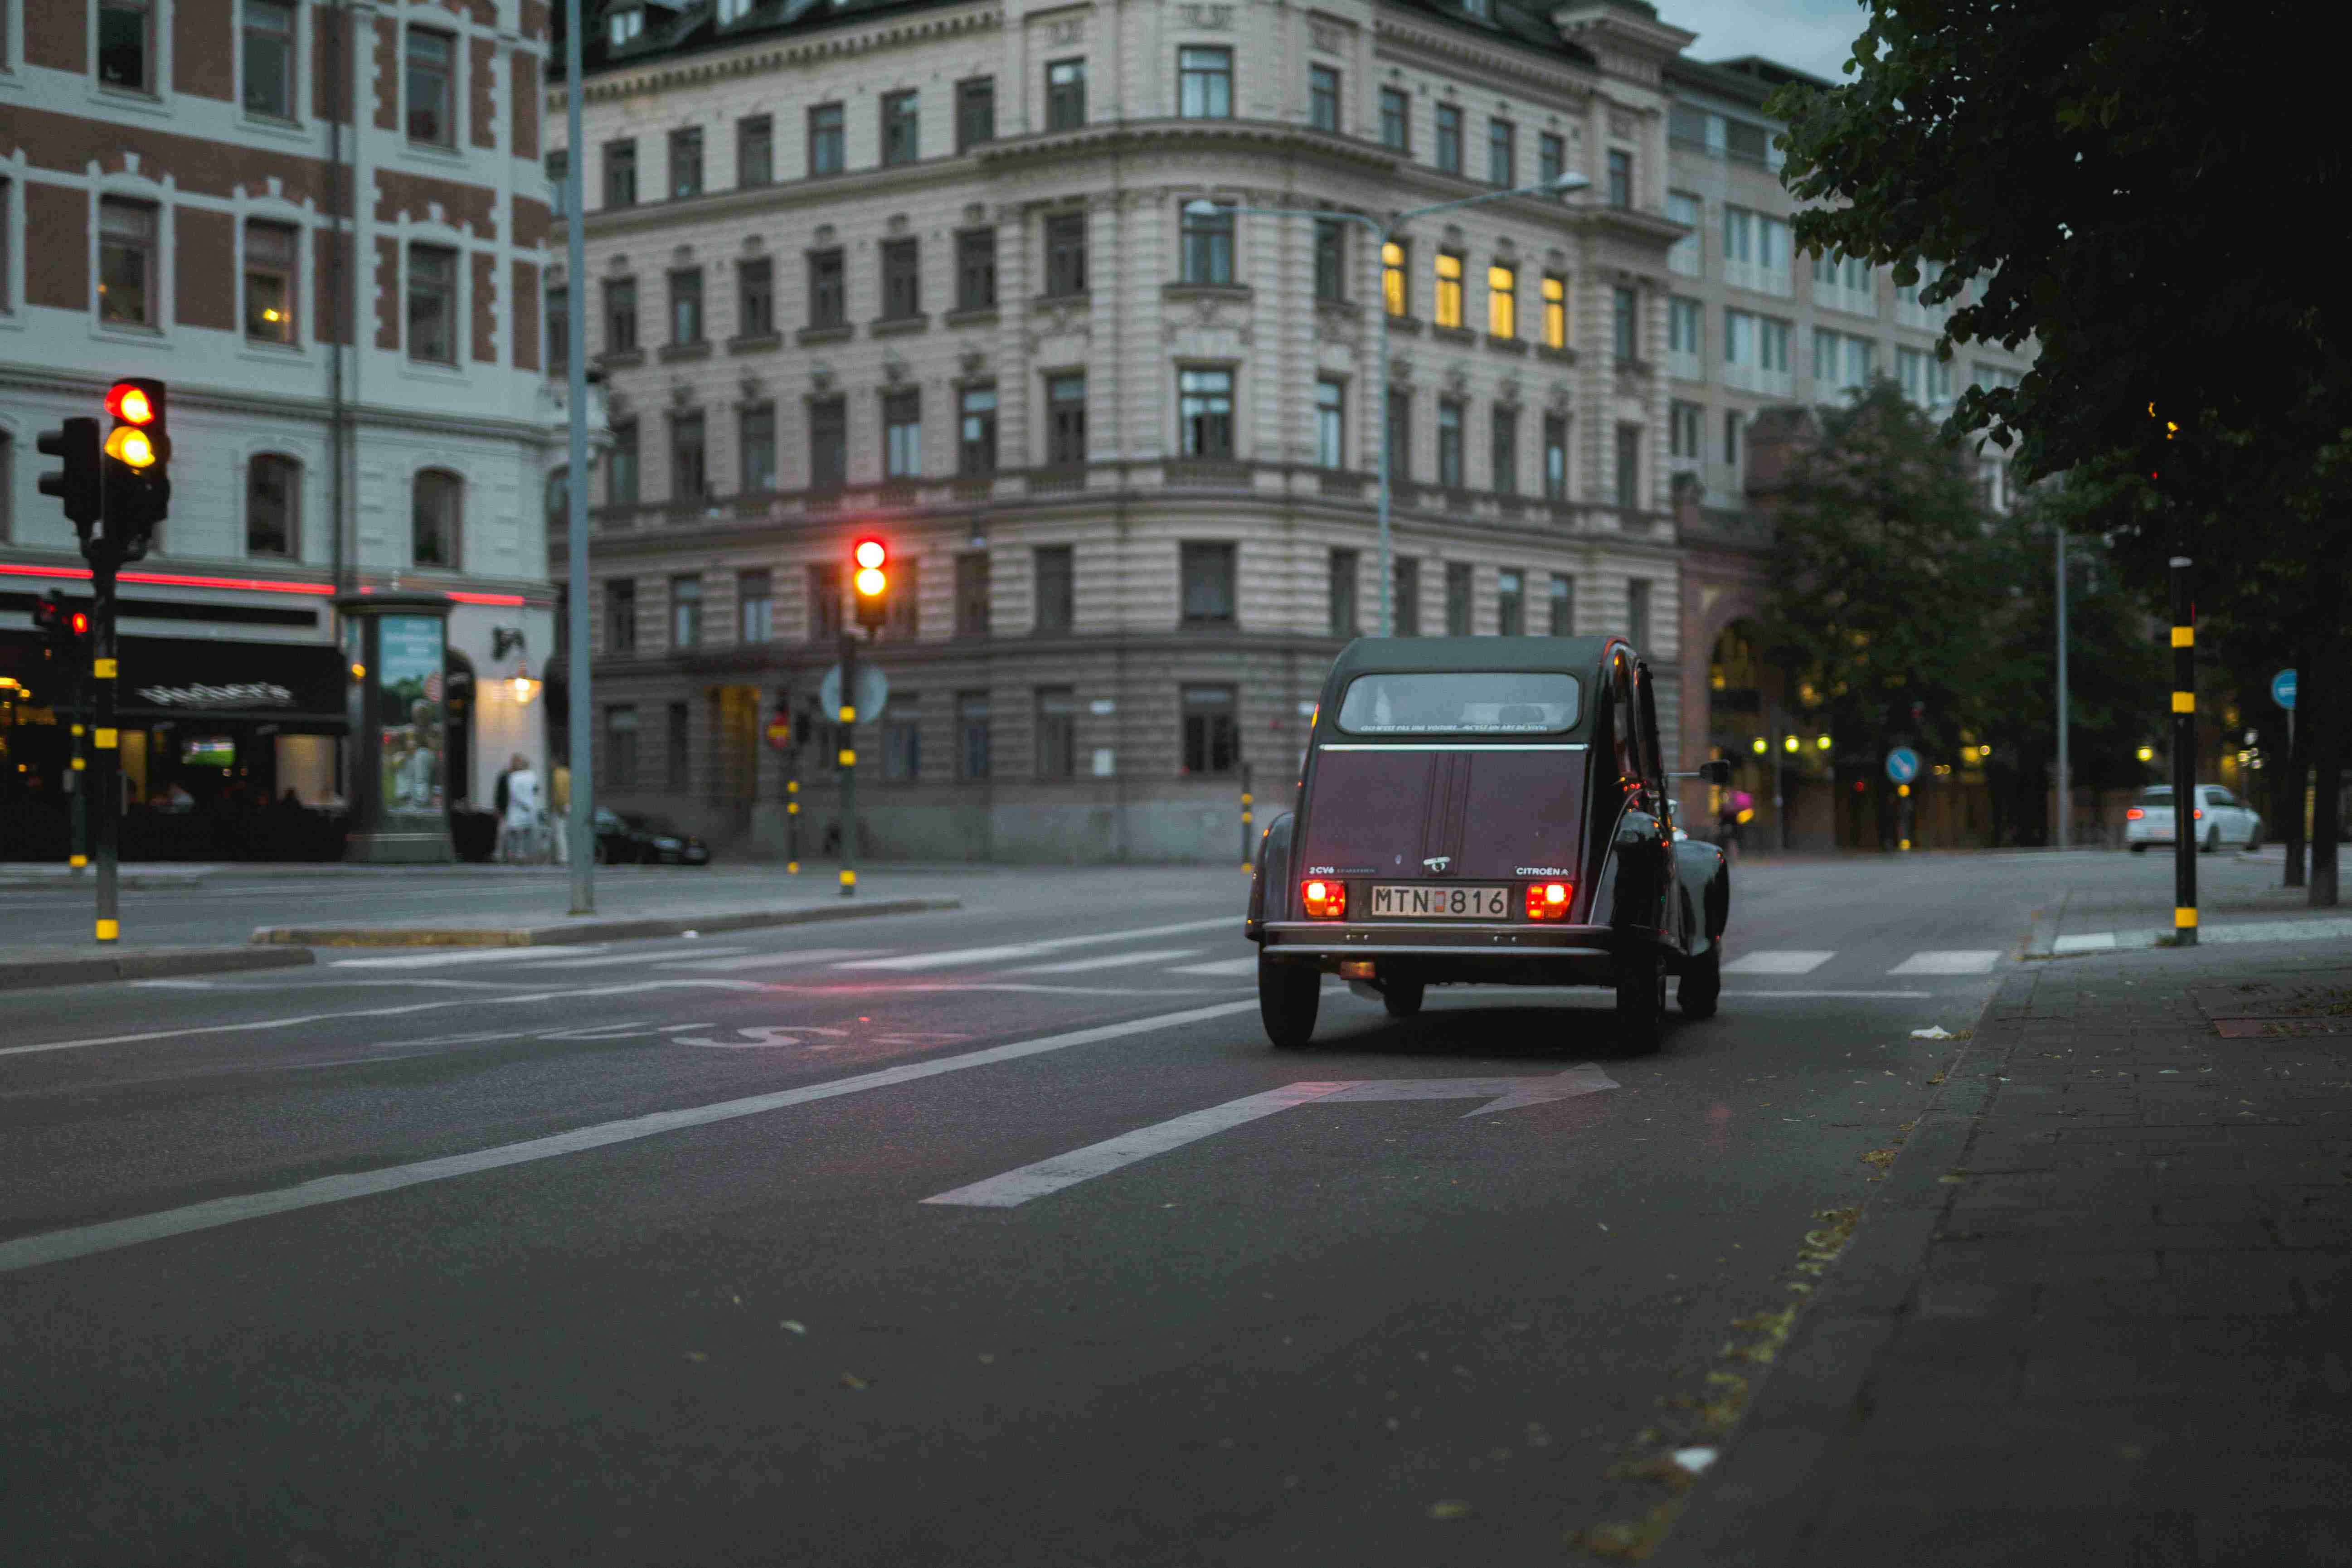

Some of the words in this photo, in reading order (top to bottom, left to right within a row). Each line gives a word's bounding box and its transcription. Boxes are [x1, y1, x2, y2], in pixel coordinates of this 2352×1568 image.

[1309, 866, 1335, 874] 2CV6
[1516, 866, 1560, 875] CITROËN
[1375, 888, 1428, 913] MTN
[1450, 889, 1504, 914] 816
